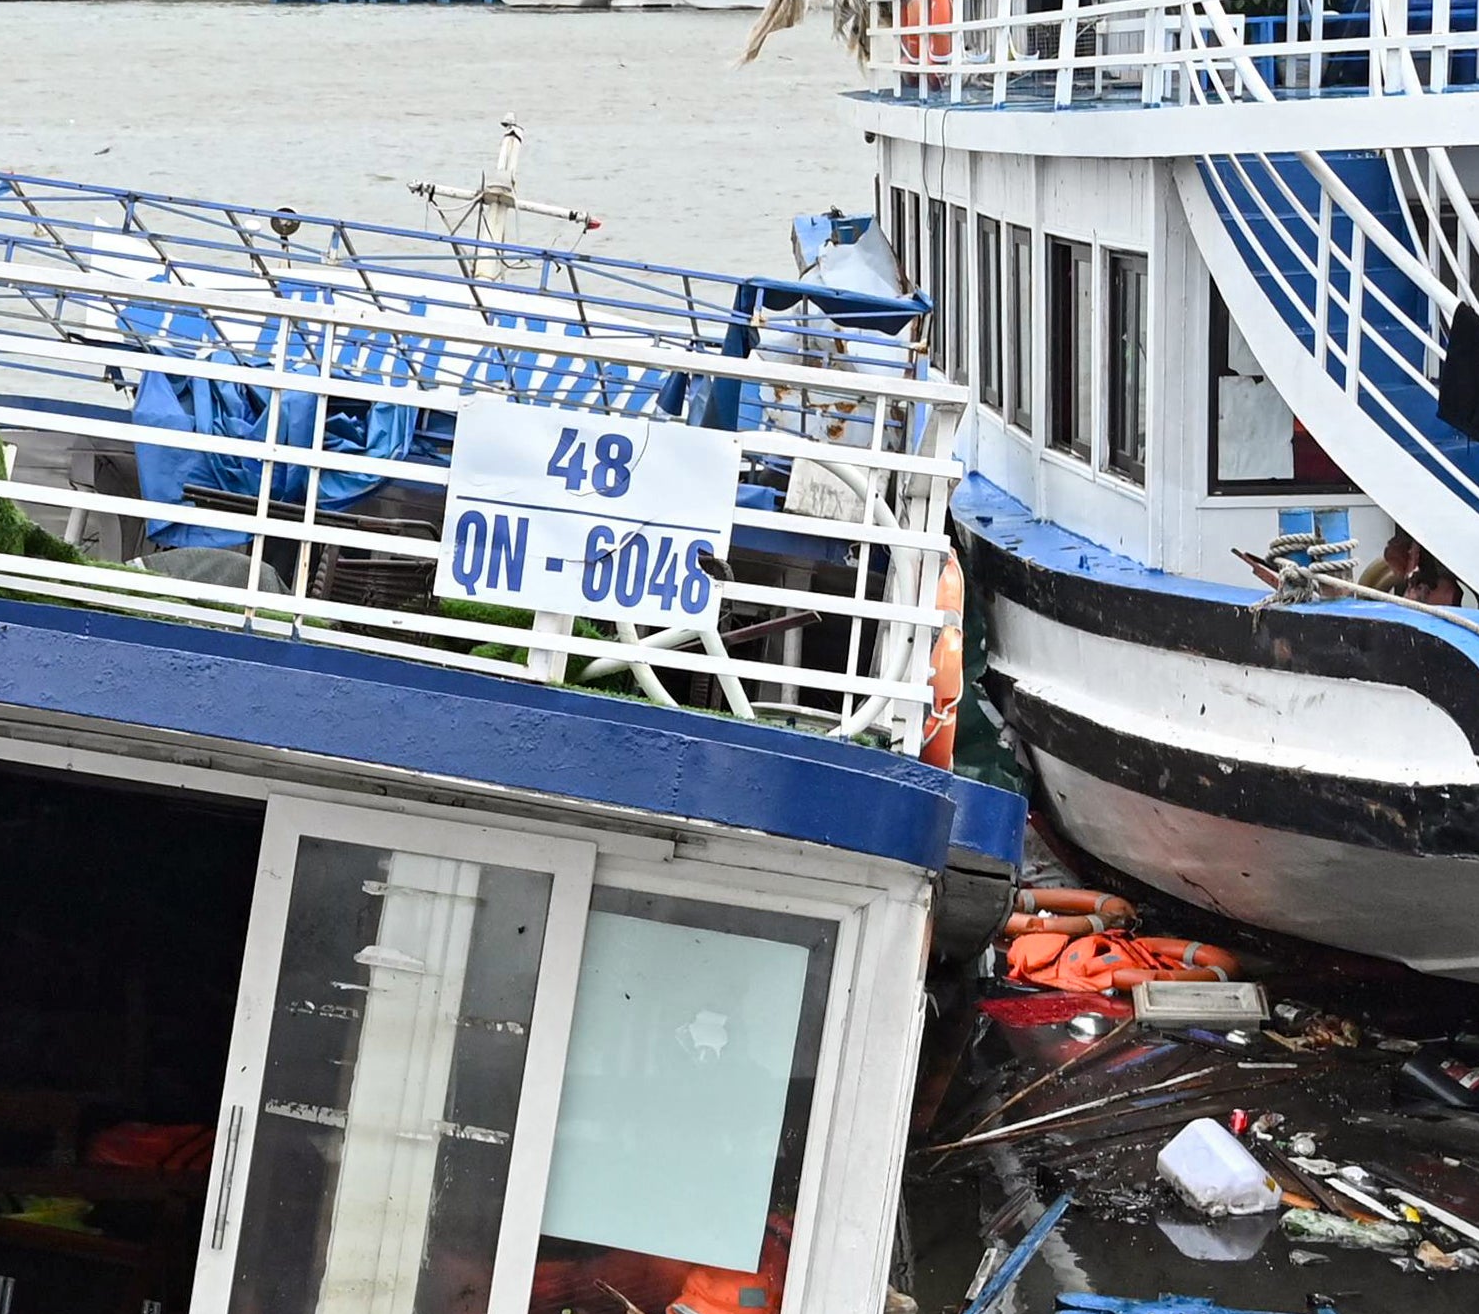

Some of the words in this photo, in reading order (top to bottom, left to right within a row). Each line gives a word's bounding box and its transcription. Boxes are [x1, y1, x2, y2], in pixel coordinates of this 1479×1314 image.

[546, 426, 634, 499] 48
[451, 509, 530, 595] QN
[581, 523, 715, 615] 6048
